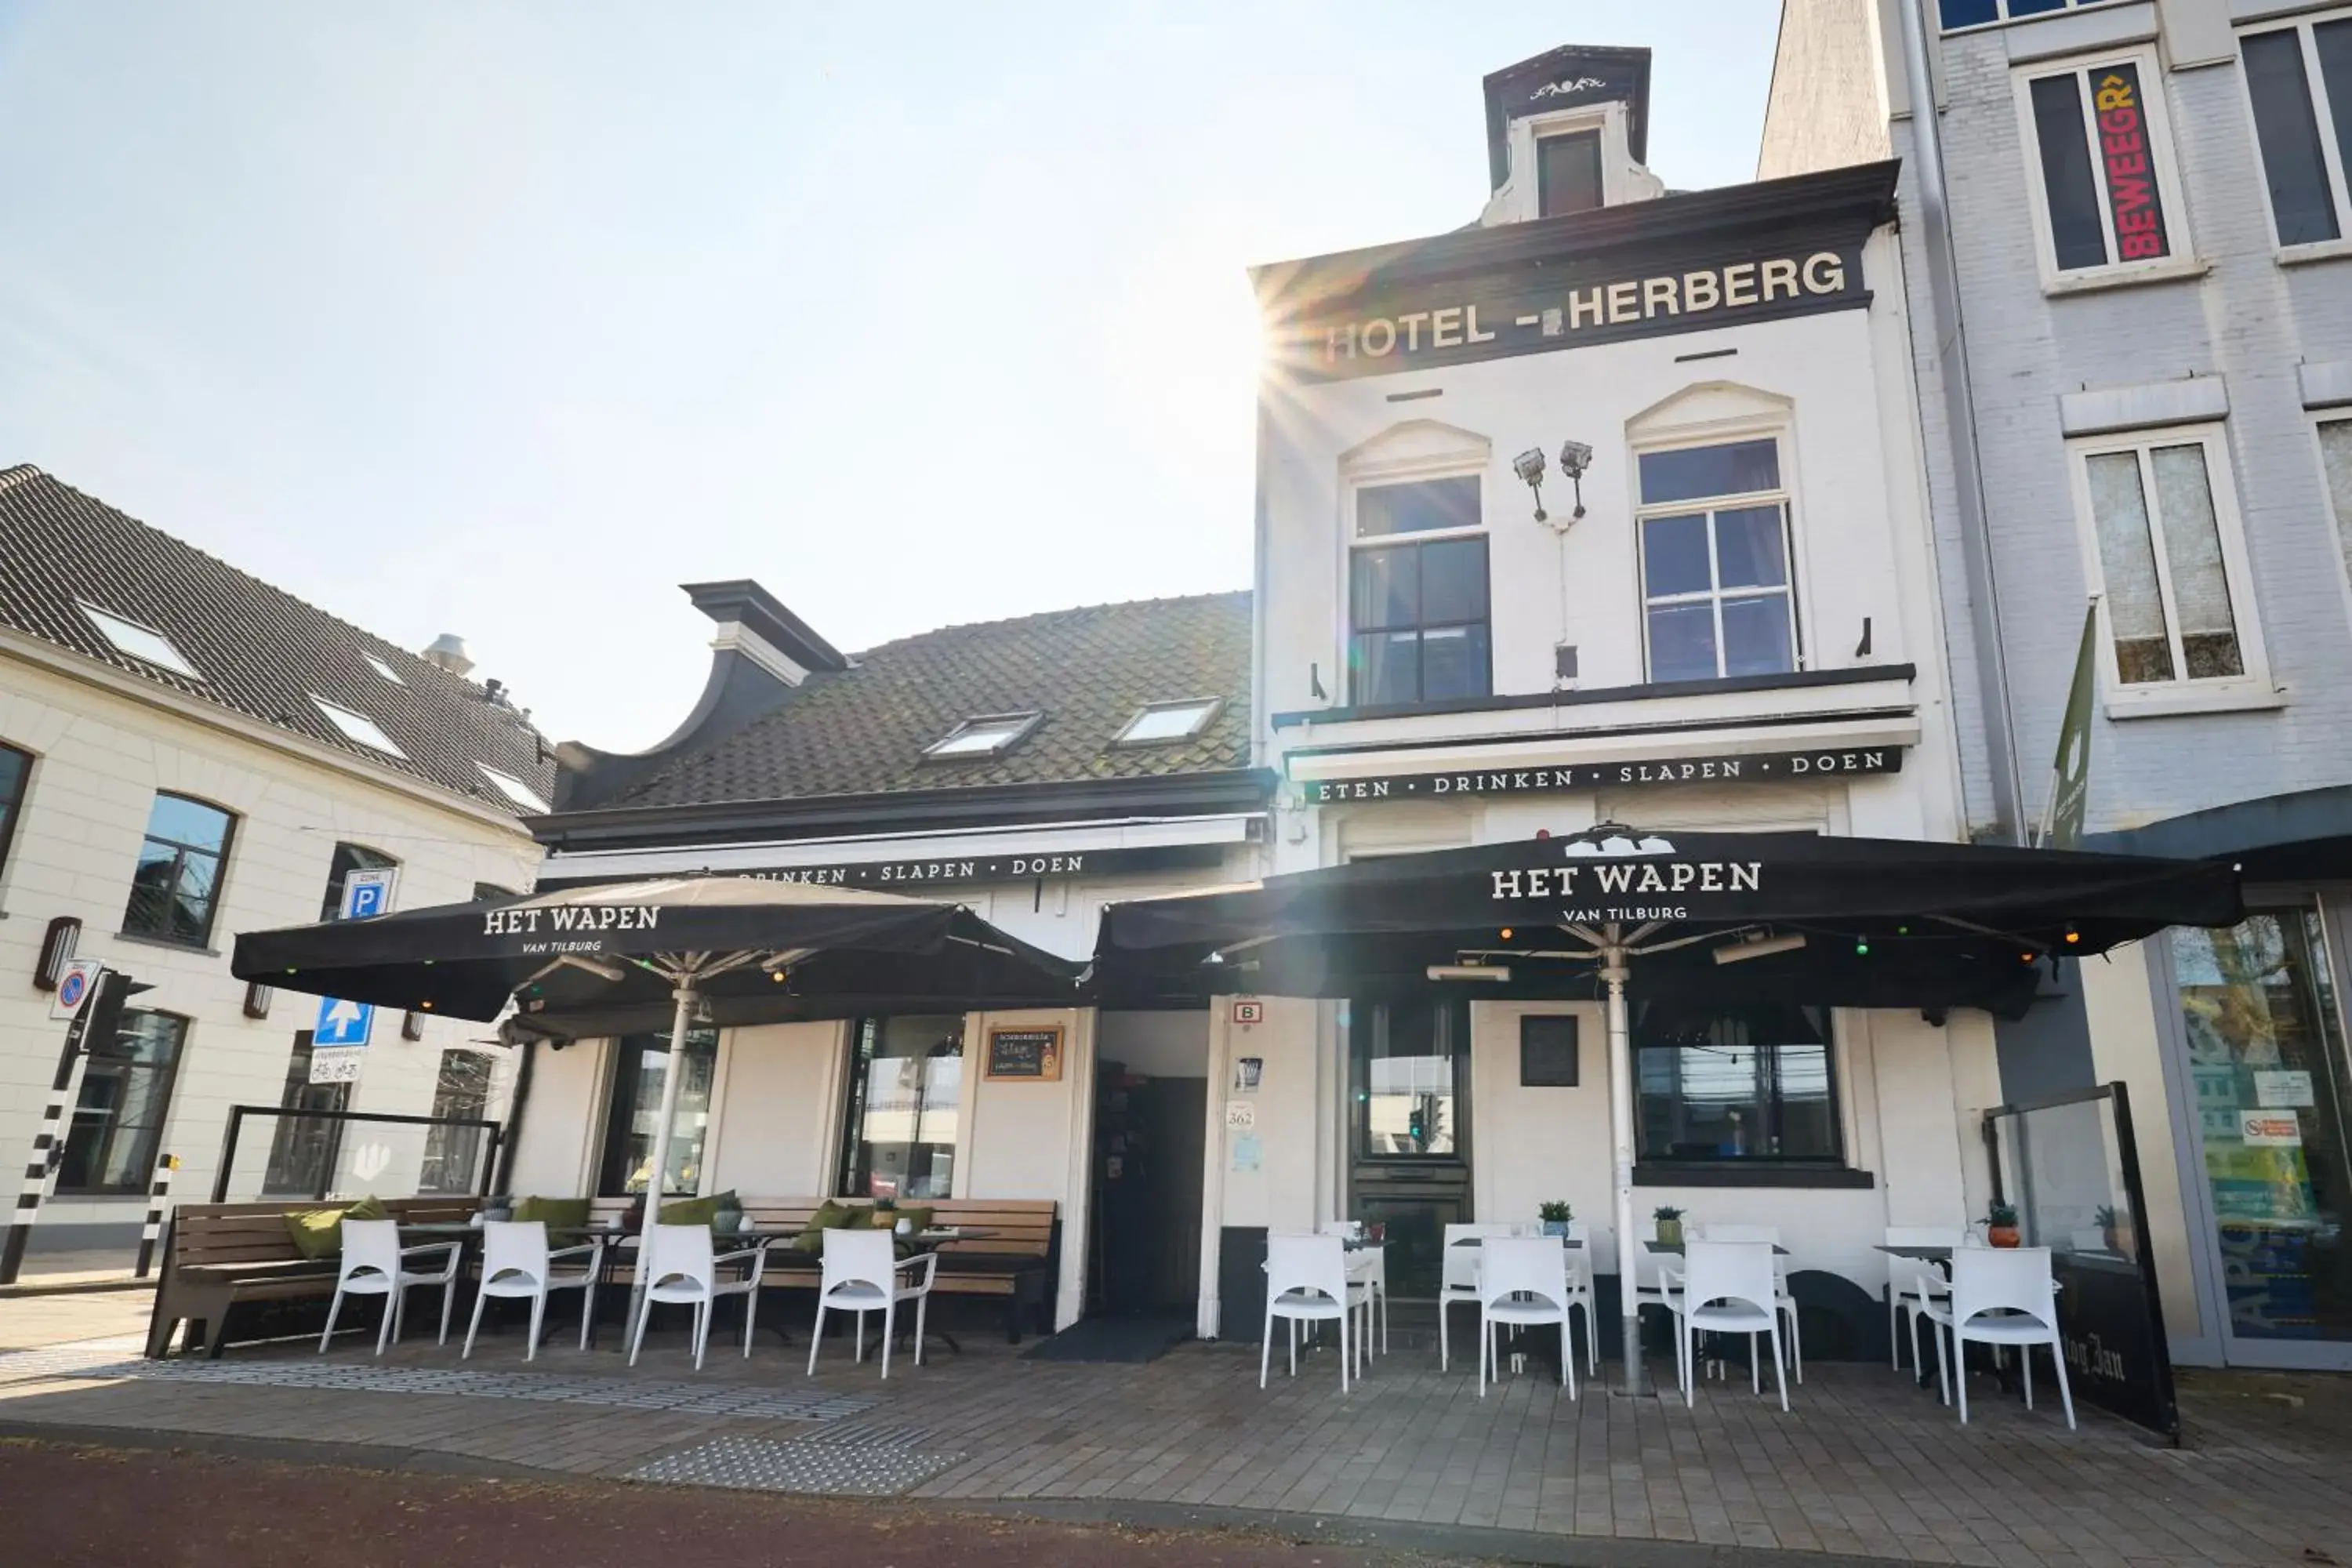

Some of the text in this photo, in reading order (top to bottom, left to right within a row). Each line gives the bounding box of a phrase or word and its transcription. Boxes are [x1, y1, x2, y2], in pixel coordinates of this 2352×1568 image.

[1326, 304, 1496, 362] HOTEL
[1569, 252, 1845, 329] HERBERG
[1319, 752, 1883, 800] ETEN DRINKEN SLAPEN DOEN
[880, 862, 975, 880] SLAPEN
[1012, 856, 1083, 874] DOEN
[1491, 862, 1762, 899] HET WAPEN
[356, 889, 376, 913] P
[1563, 906, 1687, 922] VAN TILBURG
[483, 906, 661, 935] HET WAPEN
[522, 941, 602, 953] VAN TILBURG
